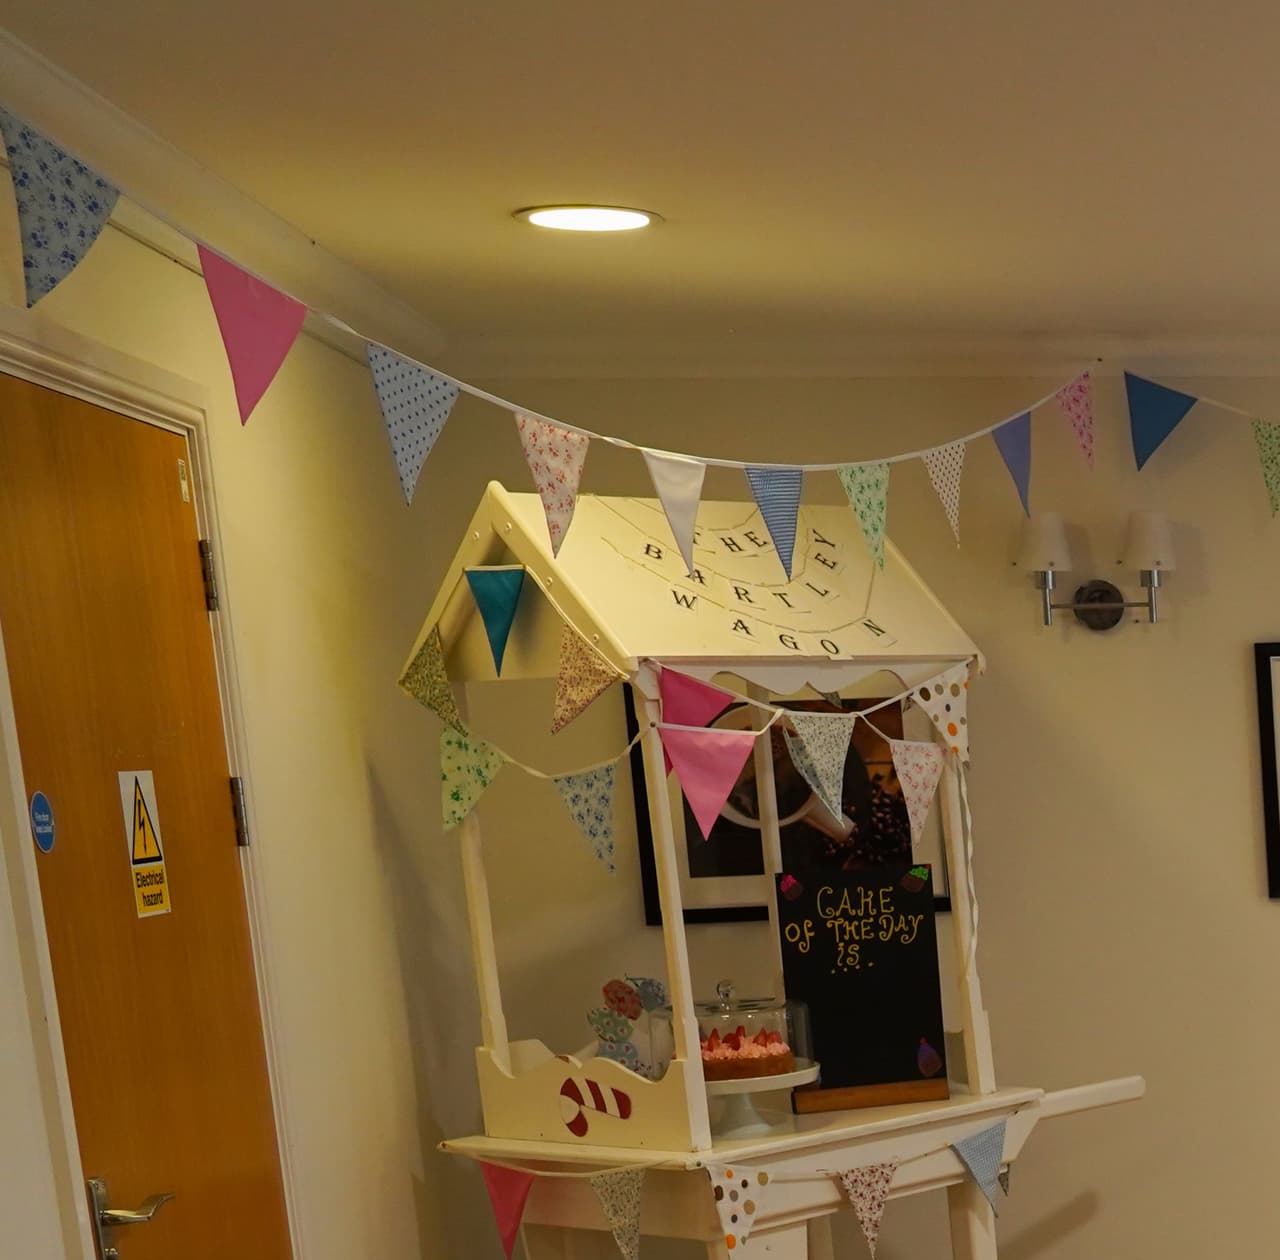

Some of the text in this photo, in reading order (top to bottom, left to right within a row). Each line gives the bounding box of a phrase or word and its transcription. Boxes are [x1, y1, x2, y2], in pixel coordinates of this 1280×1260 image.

[643, 528, 836, 609] BARTLEY
[671, 590, 886, 655] WAGON
[135, 869, 165, 889] Electrical
[141, 889, 164, 907] hazard
[816, 885, 895, 919] CAKE
[826, 918, 875, 943] THE
[878, 914, 924, 944] DAY
